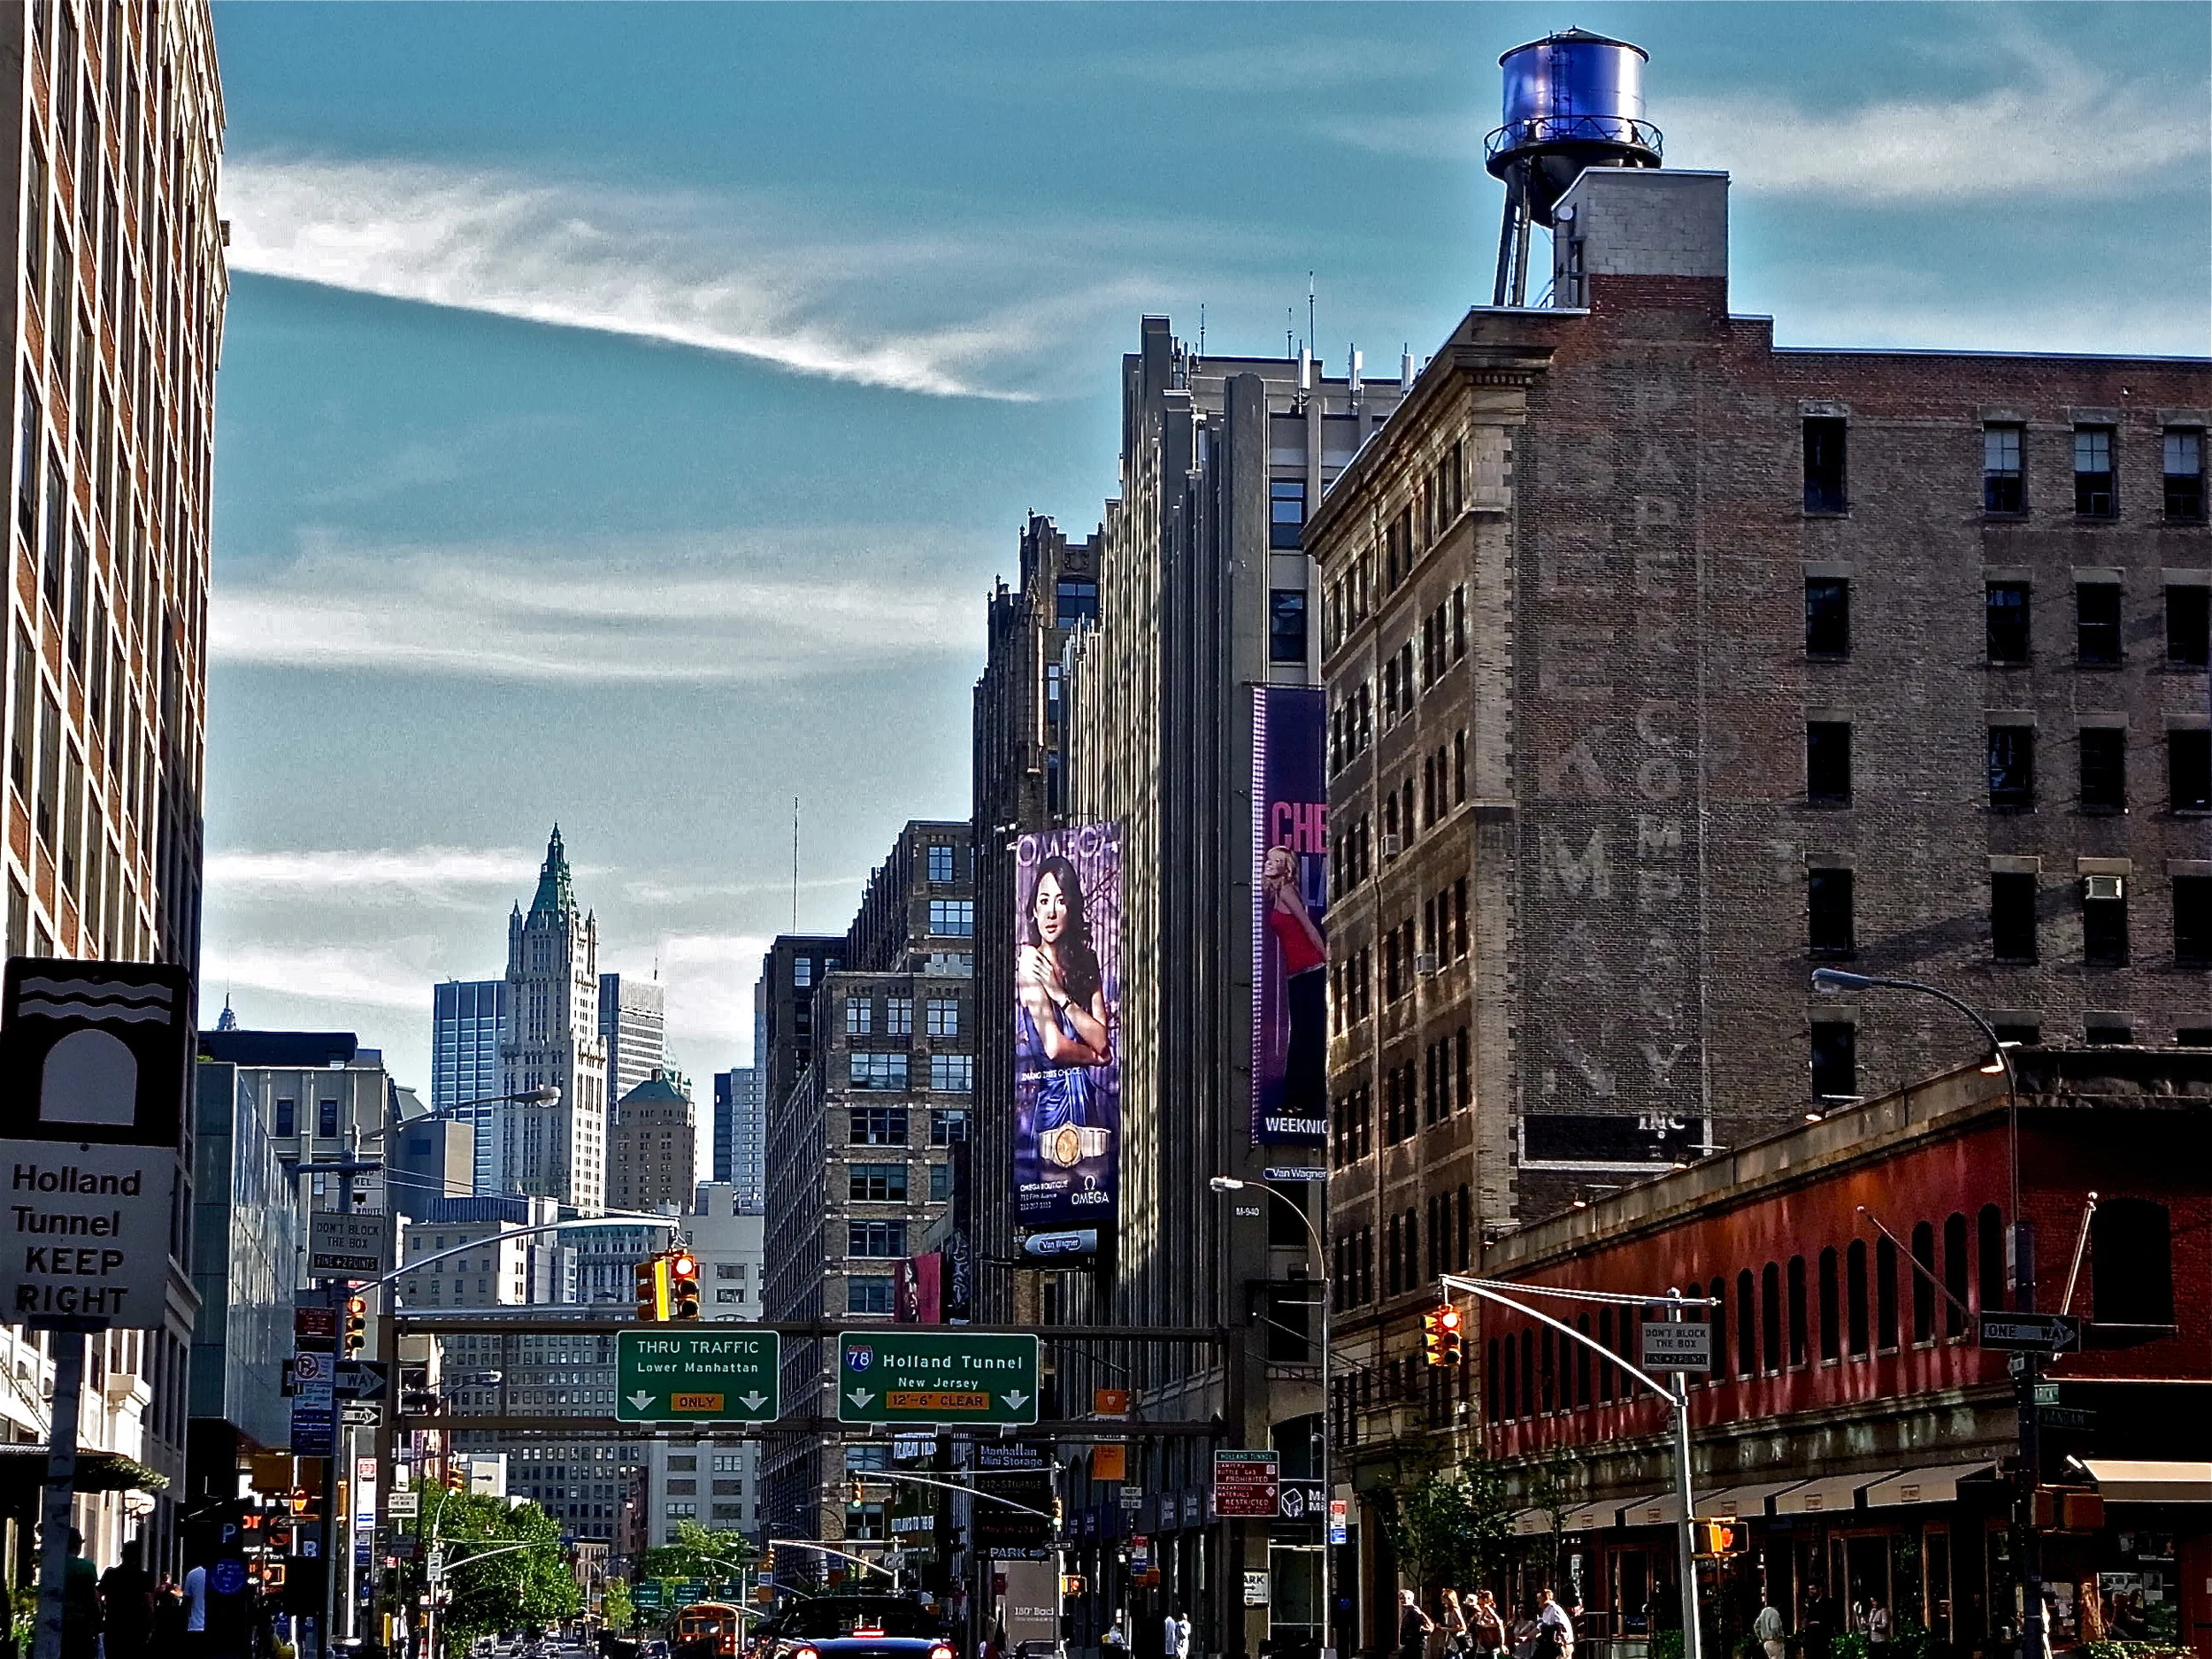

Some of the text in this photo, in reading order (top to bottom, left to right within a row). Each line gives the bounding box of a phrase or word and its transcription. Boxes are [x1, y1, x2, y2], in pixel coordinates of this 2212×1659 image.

[12, 1164, 142, 1196] Holland
[1273, 1168, 1327, 1180] Van Wagner
[1019, 1183, 1041, 1192] OMEGA
[1071, 1191, 1110, 1205] OMEGA
[1235, 1207, 1260, 1216] M-940
[11, 1205, 120, 1237] Tunnel
[349, 1225, 380, 1236] BLOCK
[327, 1236, 368, 1249] THE BOX
[26, 1246, 124, 1276] KEEP
[317, 1256, 334, 1266] FINE
[15, 1284, 129, 1315] RIGHT
[1676, 1329, 1706, 1338] BLOCK
[1988, 1325, 2068, 1339] ONE WAY
[637, 1340, 759, 1354] THRU TRAFFIC
[1655, 1339, 1697, 1348] THE BOX
[848, 1351, 871, 1367] 78
[883, 1355, 1022, 1370] Holland Tunnel
[637, 1362, 758, 1372] Lower Manhattan
[347, 1374, 378, 1386] WAY
[898, 1377, 979, 1390] New Jersey
[679, 1396, 716, 1408] ONLY
[940, 1394, 983, 1407] CLEAR
[980, 1442, 1037, 1456] Manhattan
[980, 1455, 1043, 1467] Mini Storage
[990, 1548, 1026, 1558] PARK
